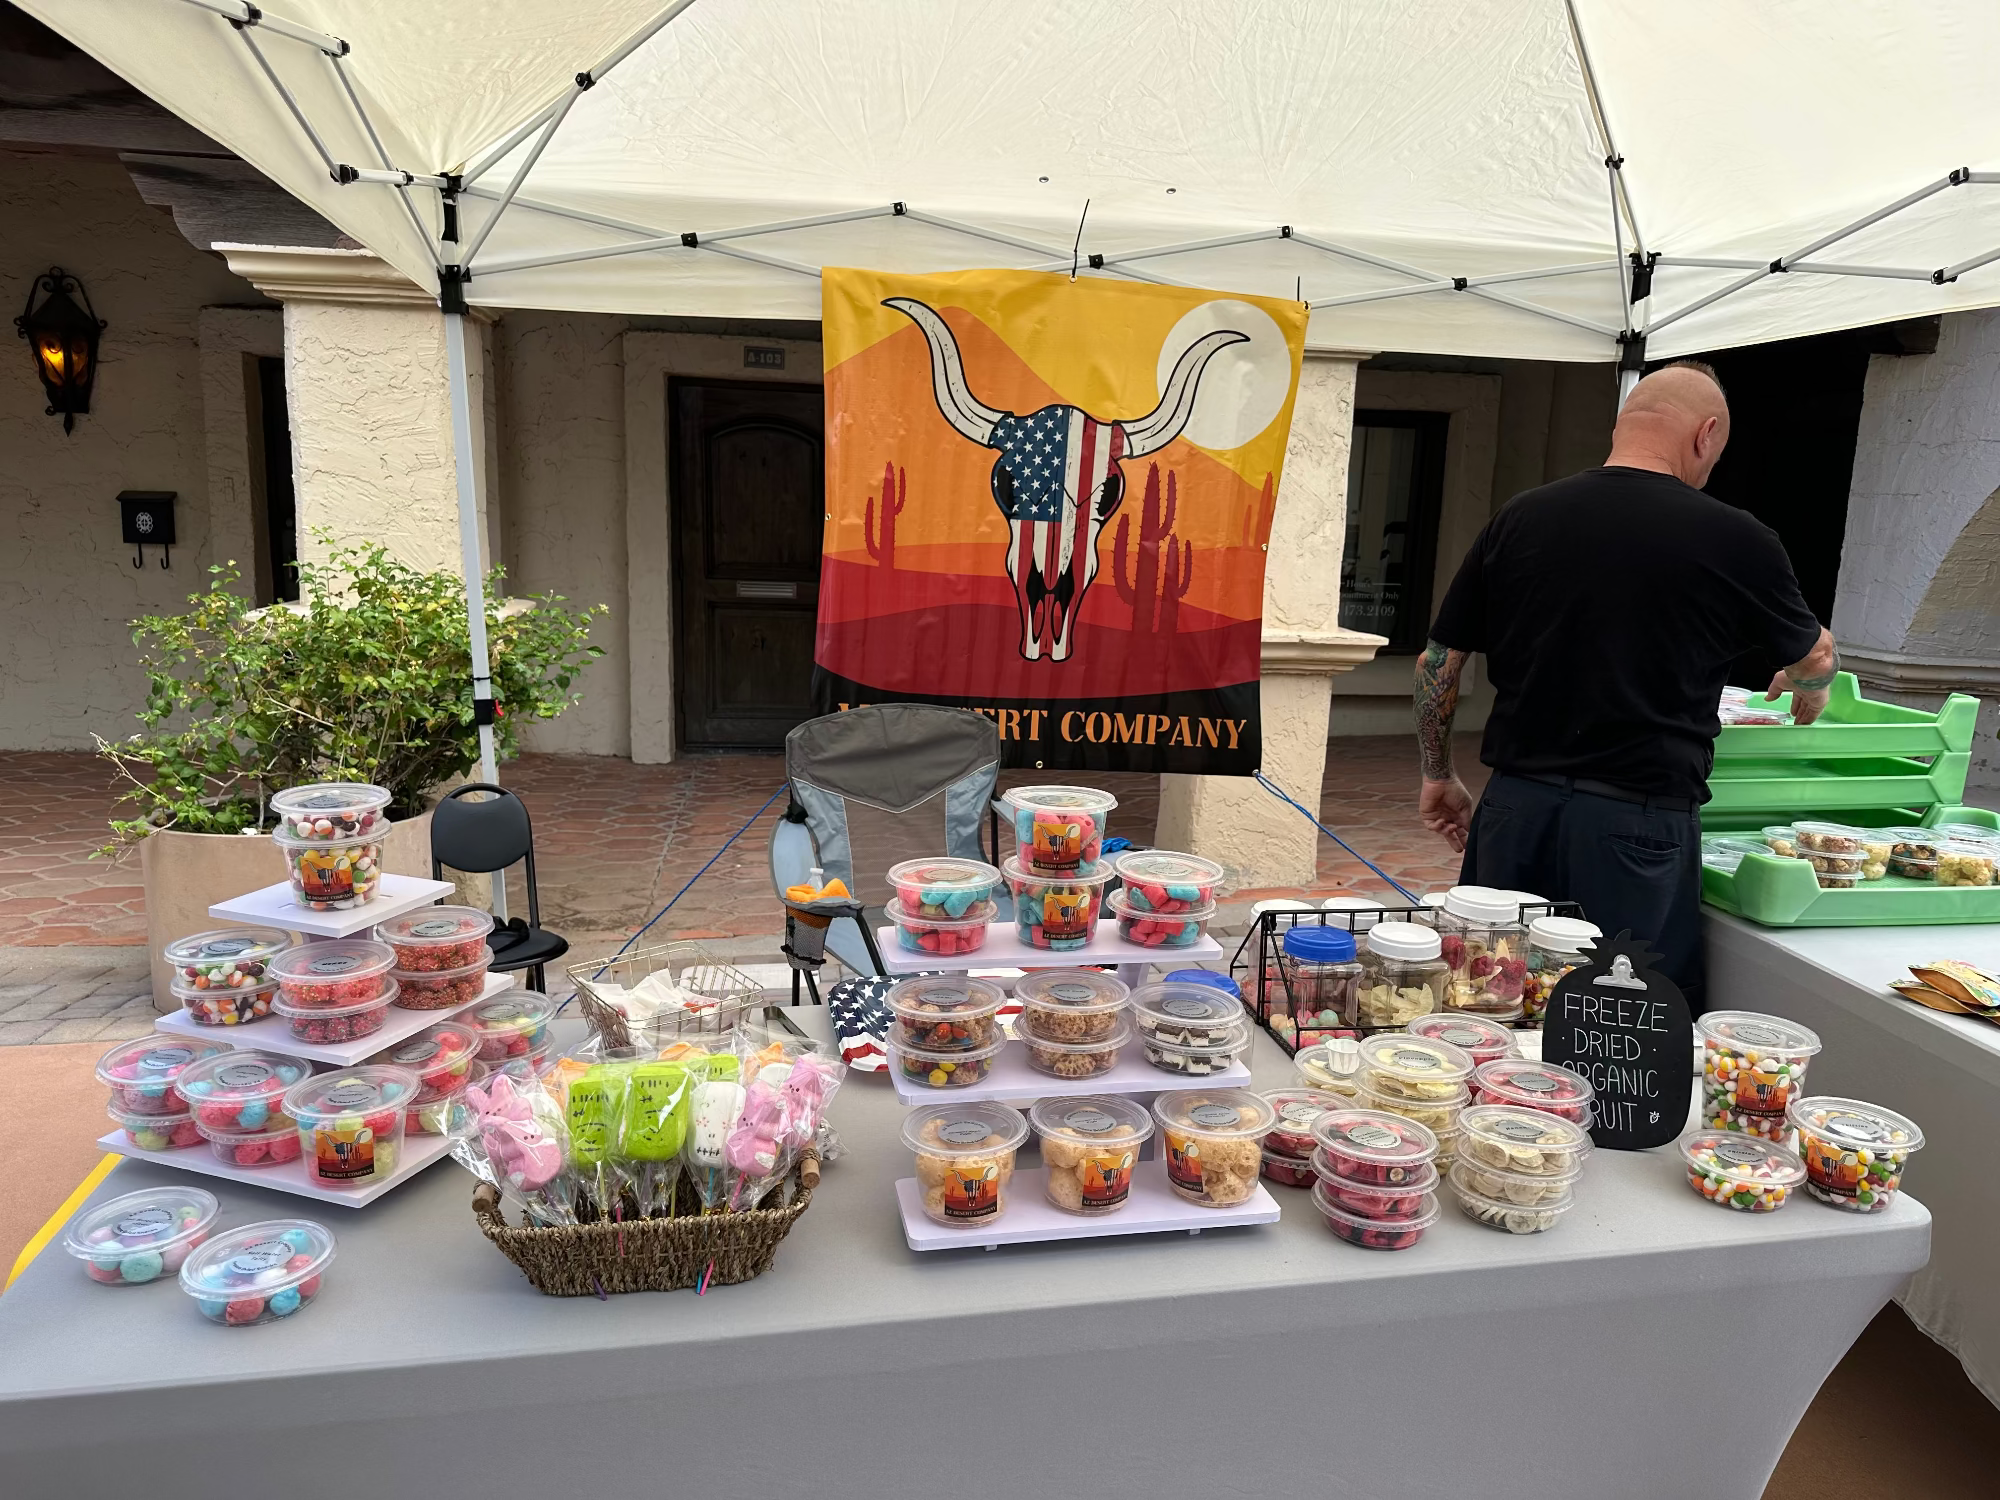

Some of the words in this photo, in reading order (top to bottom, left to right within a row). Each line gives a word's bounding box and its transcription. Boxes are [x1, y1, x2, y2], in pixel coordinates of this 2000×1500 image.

[1060, 710, 1247, 750] COMPANY
[1563, 992, 1669, 1033] FREEZE
[1573, 1027, 1642, 1061] DRIED
[1587, 1098, 1638, 1132] RUIT
[1744, 1108, 1762, 1116] DESERT
[347, 1168, 373, 1177] COMPANY
[1830, 1187, 1856, 1197] COMPANY
